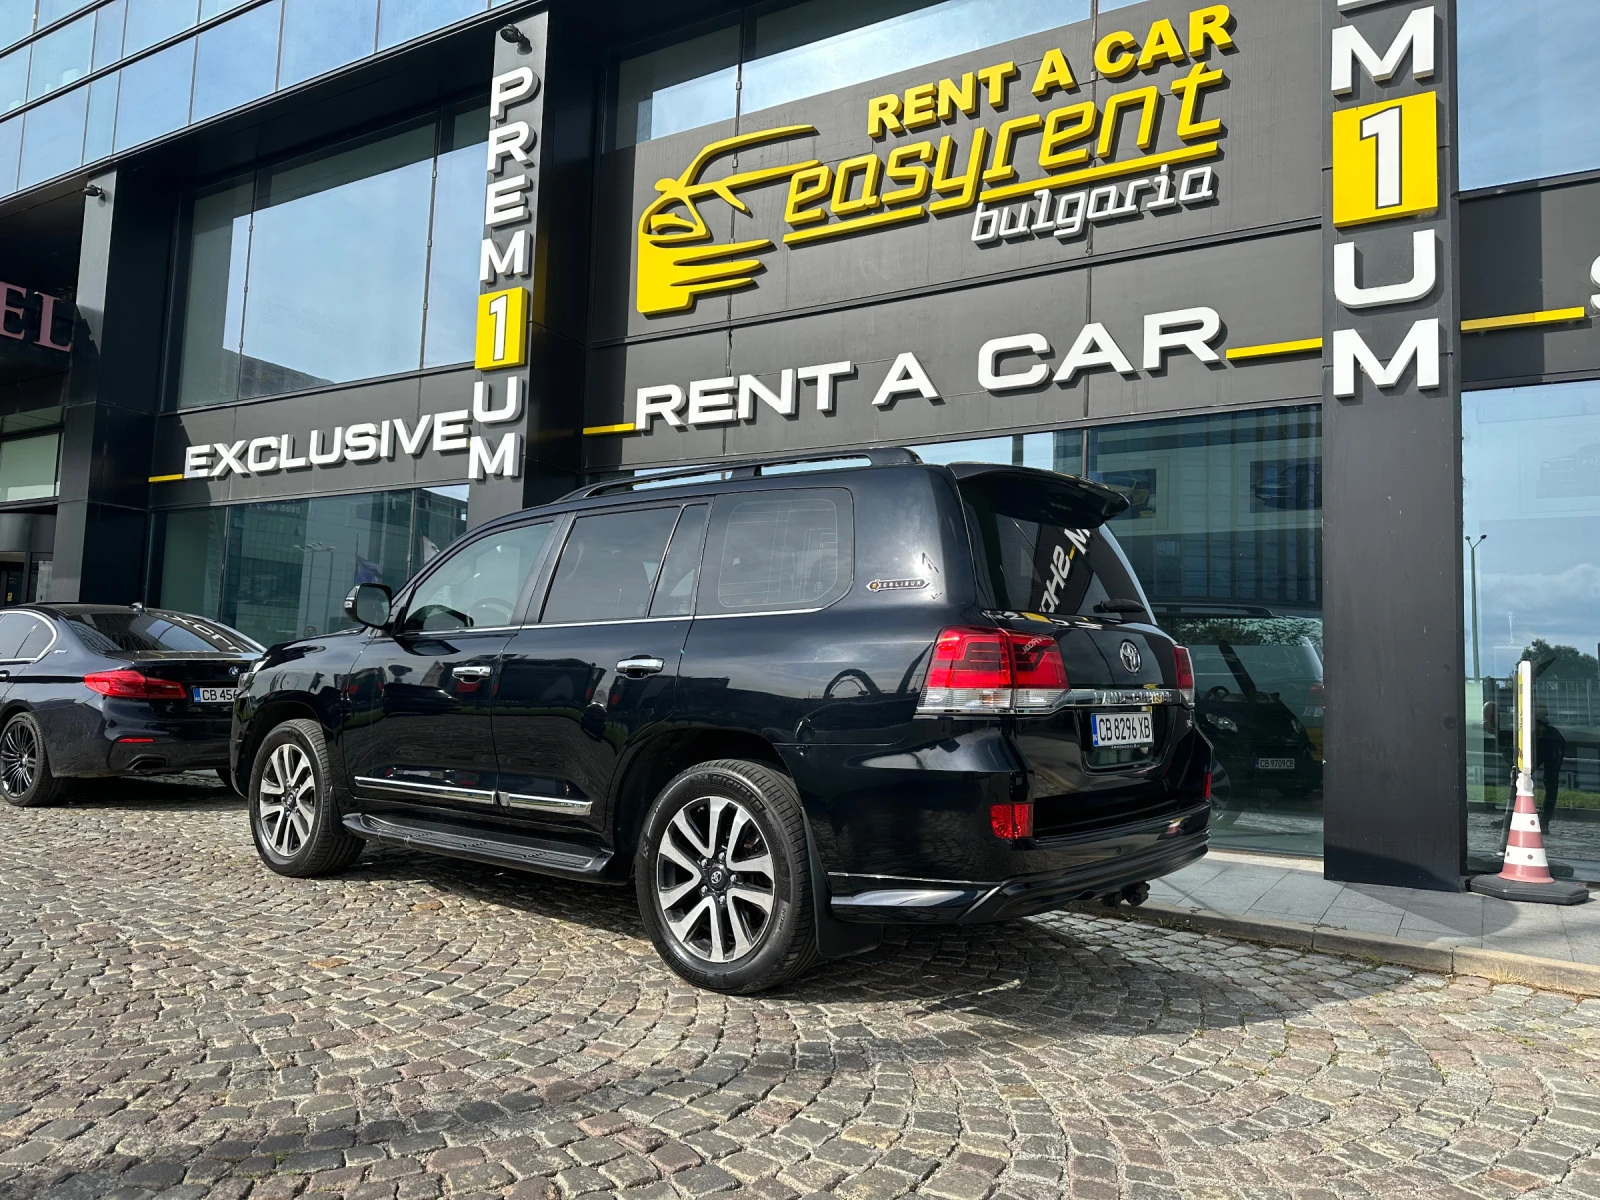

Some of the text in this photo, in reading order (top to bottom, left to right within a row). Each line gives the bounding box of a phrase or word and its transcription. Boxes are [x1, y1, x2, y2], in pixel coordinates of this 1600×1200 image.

[867, 4, 1233, 138] RENT A CAR
[783, 63, 1224, 226] easyrent
[970, 165, 1213, 245] bulgaria
[636, 306, 1222, 432] RENT A CAR
[184, 410, 470, 480] EXCLUSIVE
[202, 689, 217, 701] CB
[1099, 716, 1151, 742] CB 8296 XB
